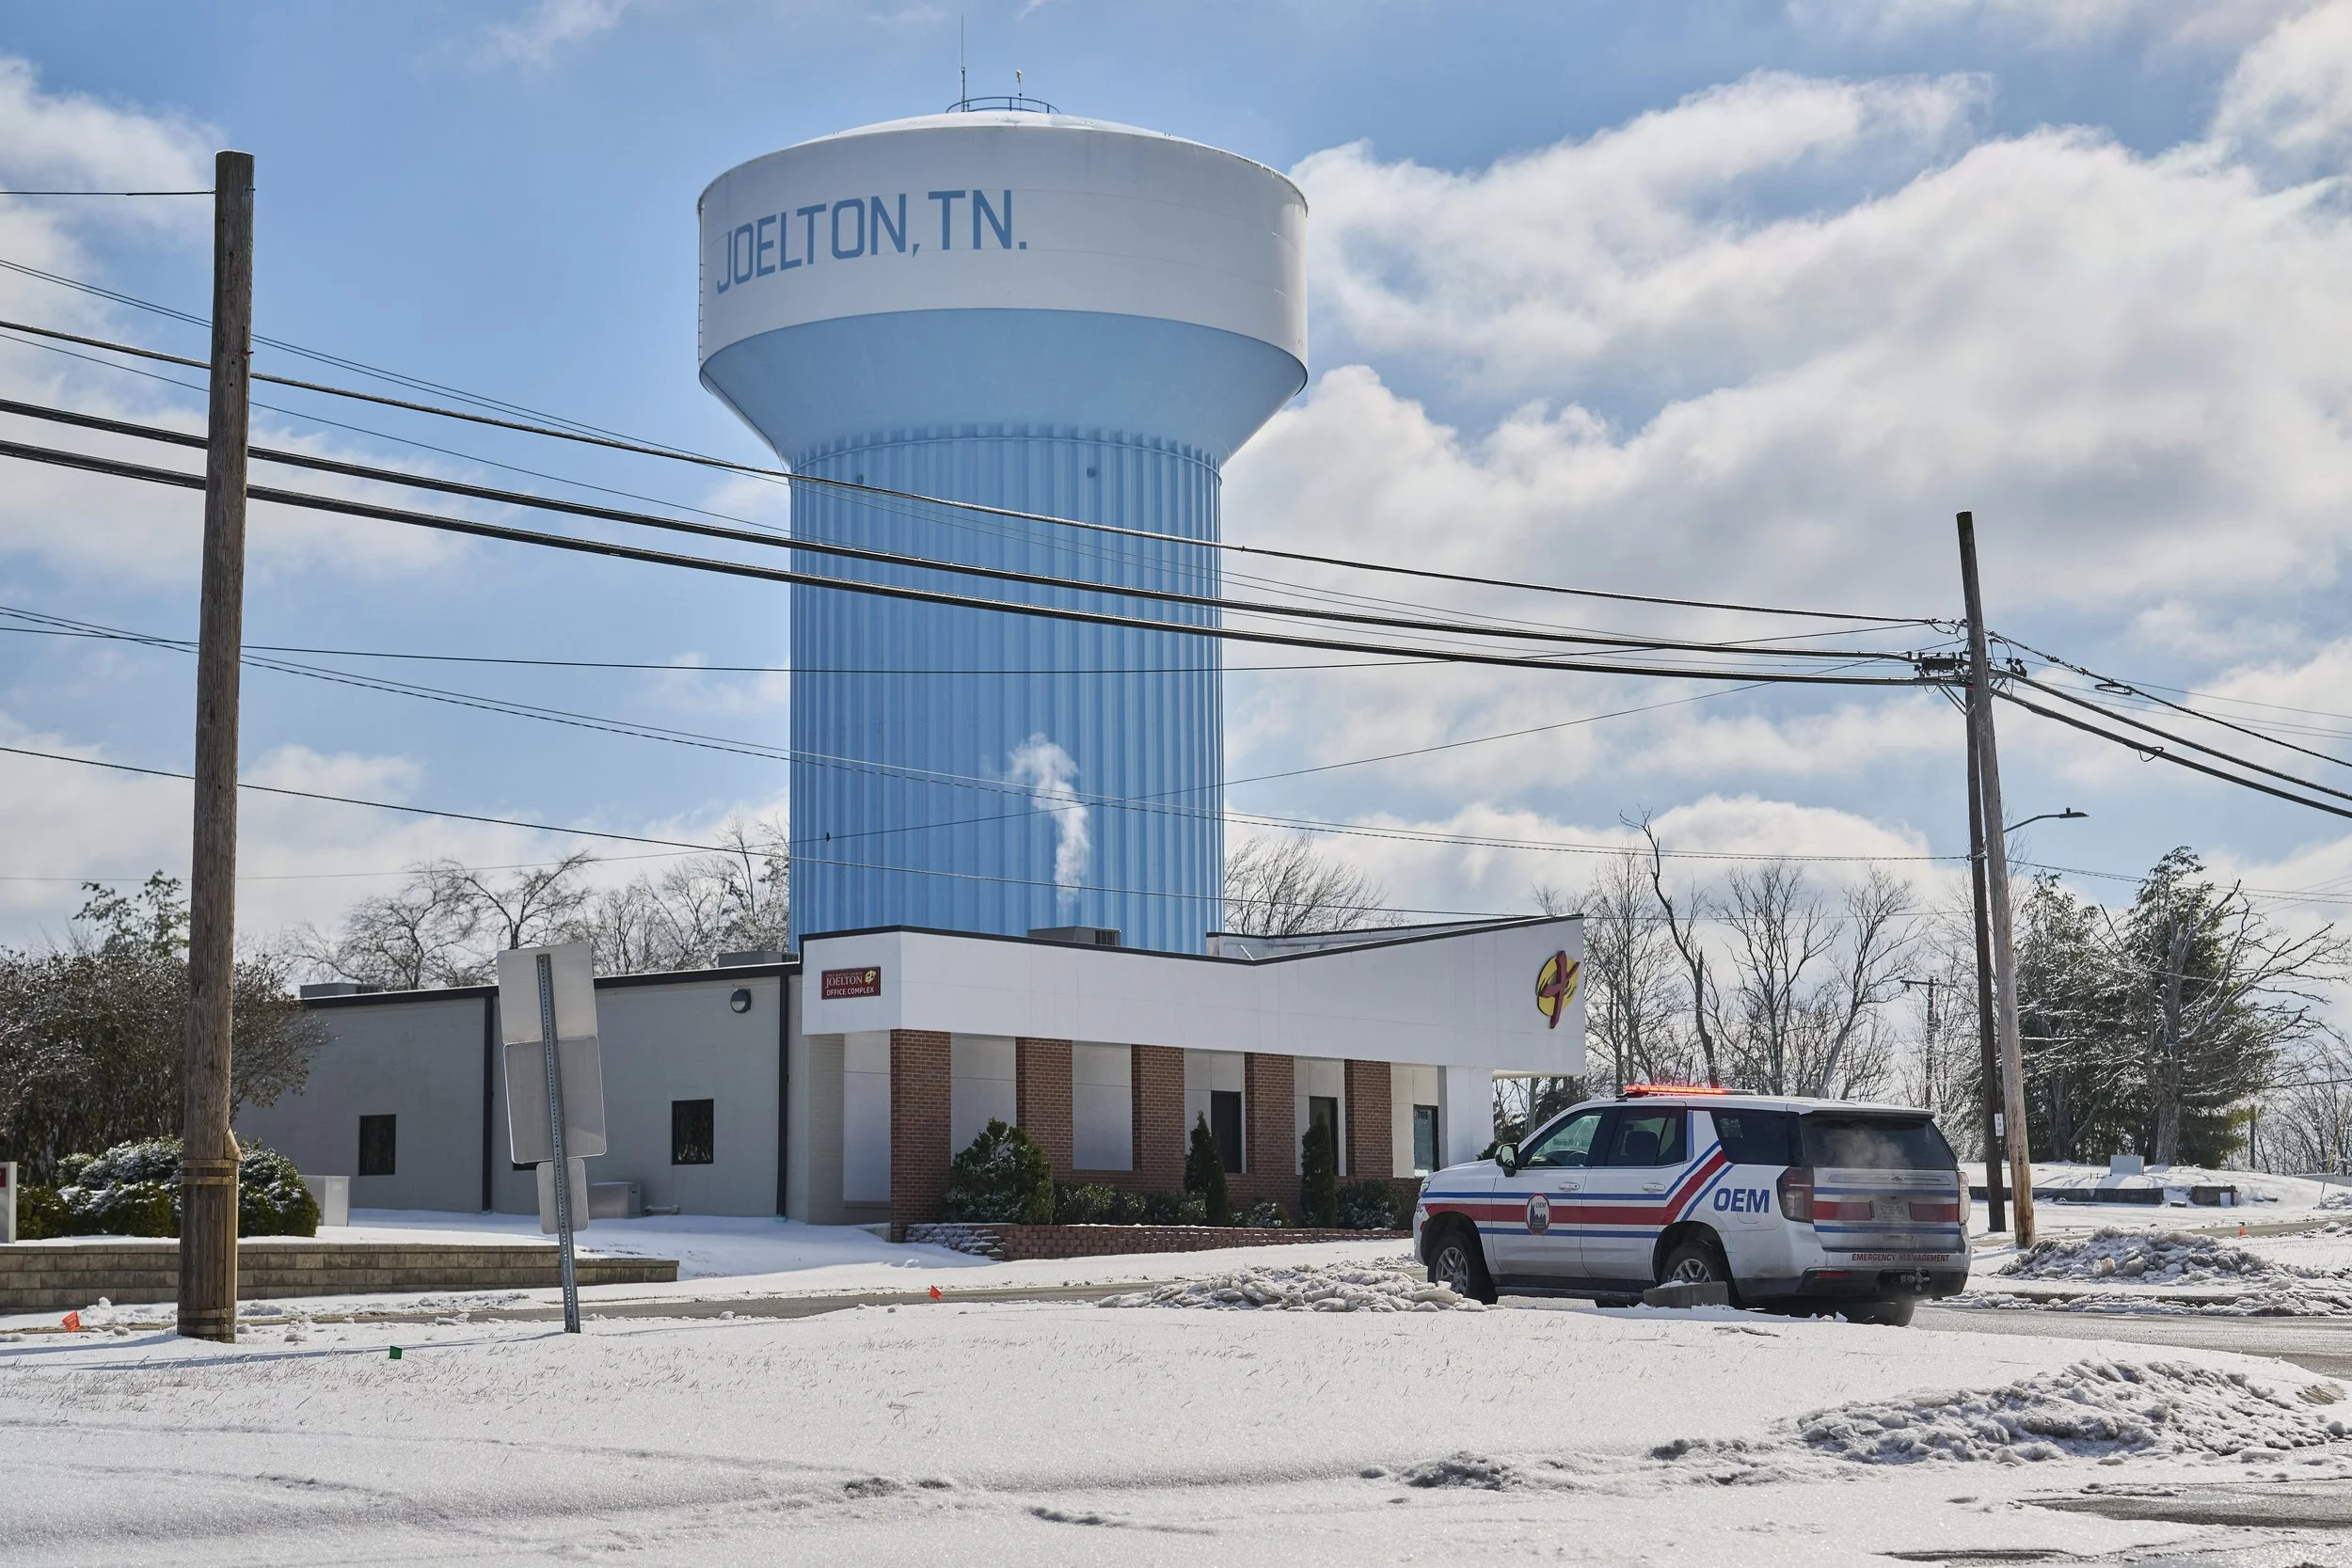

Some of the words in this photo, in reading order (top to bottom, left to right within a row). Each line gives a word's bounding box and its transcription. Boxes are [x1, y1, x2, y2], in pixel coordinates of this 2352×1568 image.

[717, 193, 921, 294] JOELTON,
[928, 189, 1027, 251] TN.
[825, 975, 863, 989] JOELTON
[826, 988, 846, 996] OFFICE
[847, 987, 874, 995] COMPLEX
[1713, 1187, 1771, 1213] OEM
[1851, 1253, 1897, 1261] EMERGENCY
[1899, 1254, 1950, 1262] MANAGEMENT
